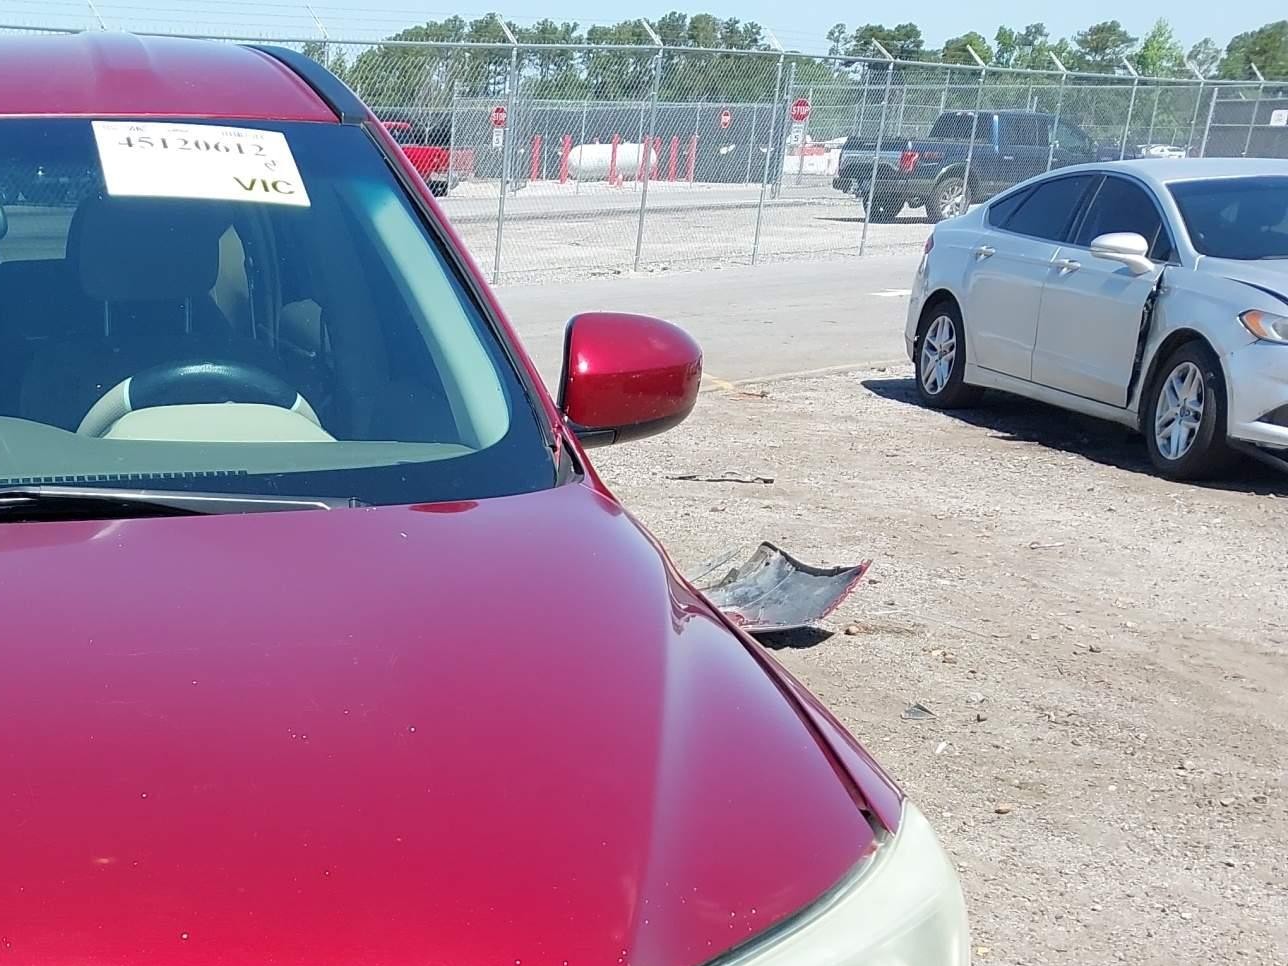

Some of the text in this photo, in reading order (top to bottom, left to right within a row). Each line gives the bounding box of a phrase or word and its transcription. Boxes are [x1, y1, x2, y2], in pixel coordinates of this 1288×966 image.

[492, 112, 506, 121] STOP
[792, 105, 810, 115] STOP
[118, 135, 267, 157] 45120612
[233, 176, 295, 195] VIC
